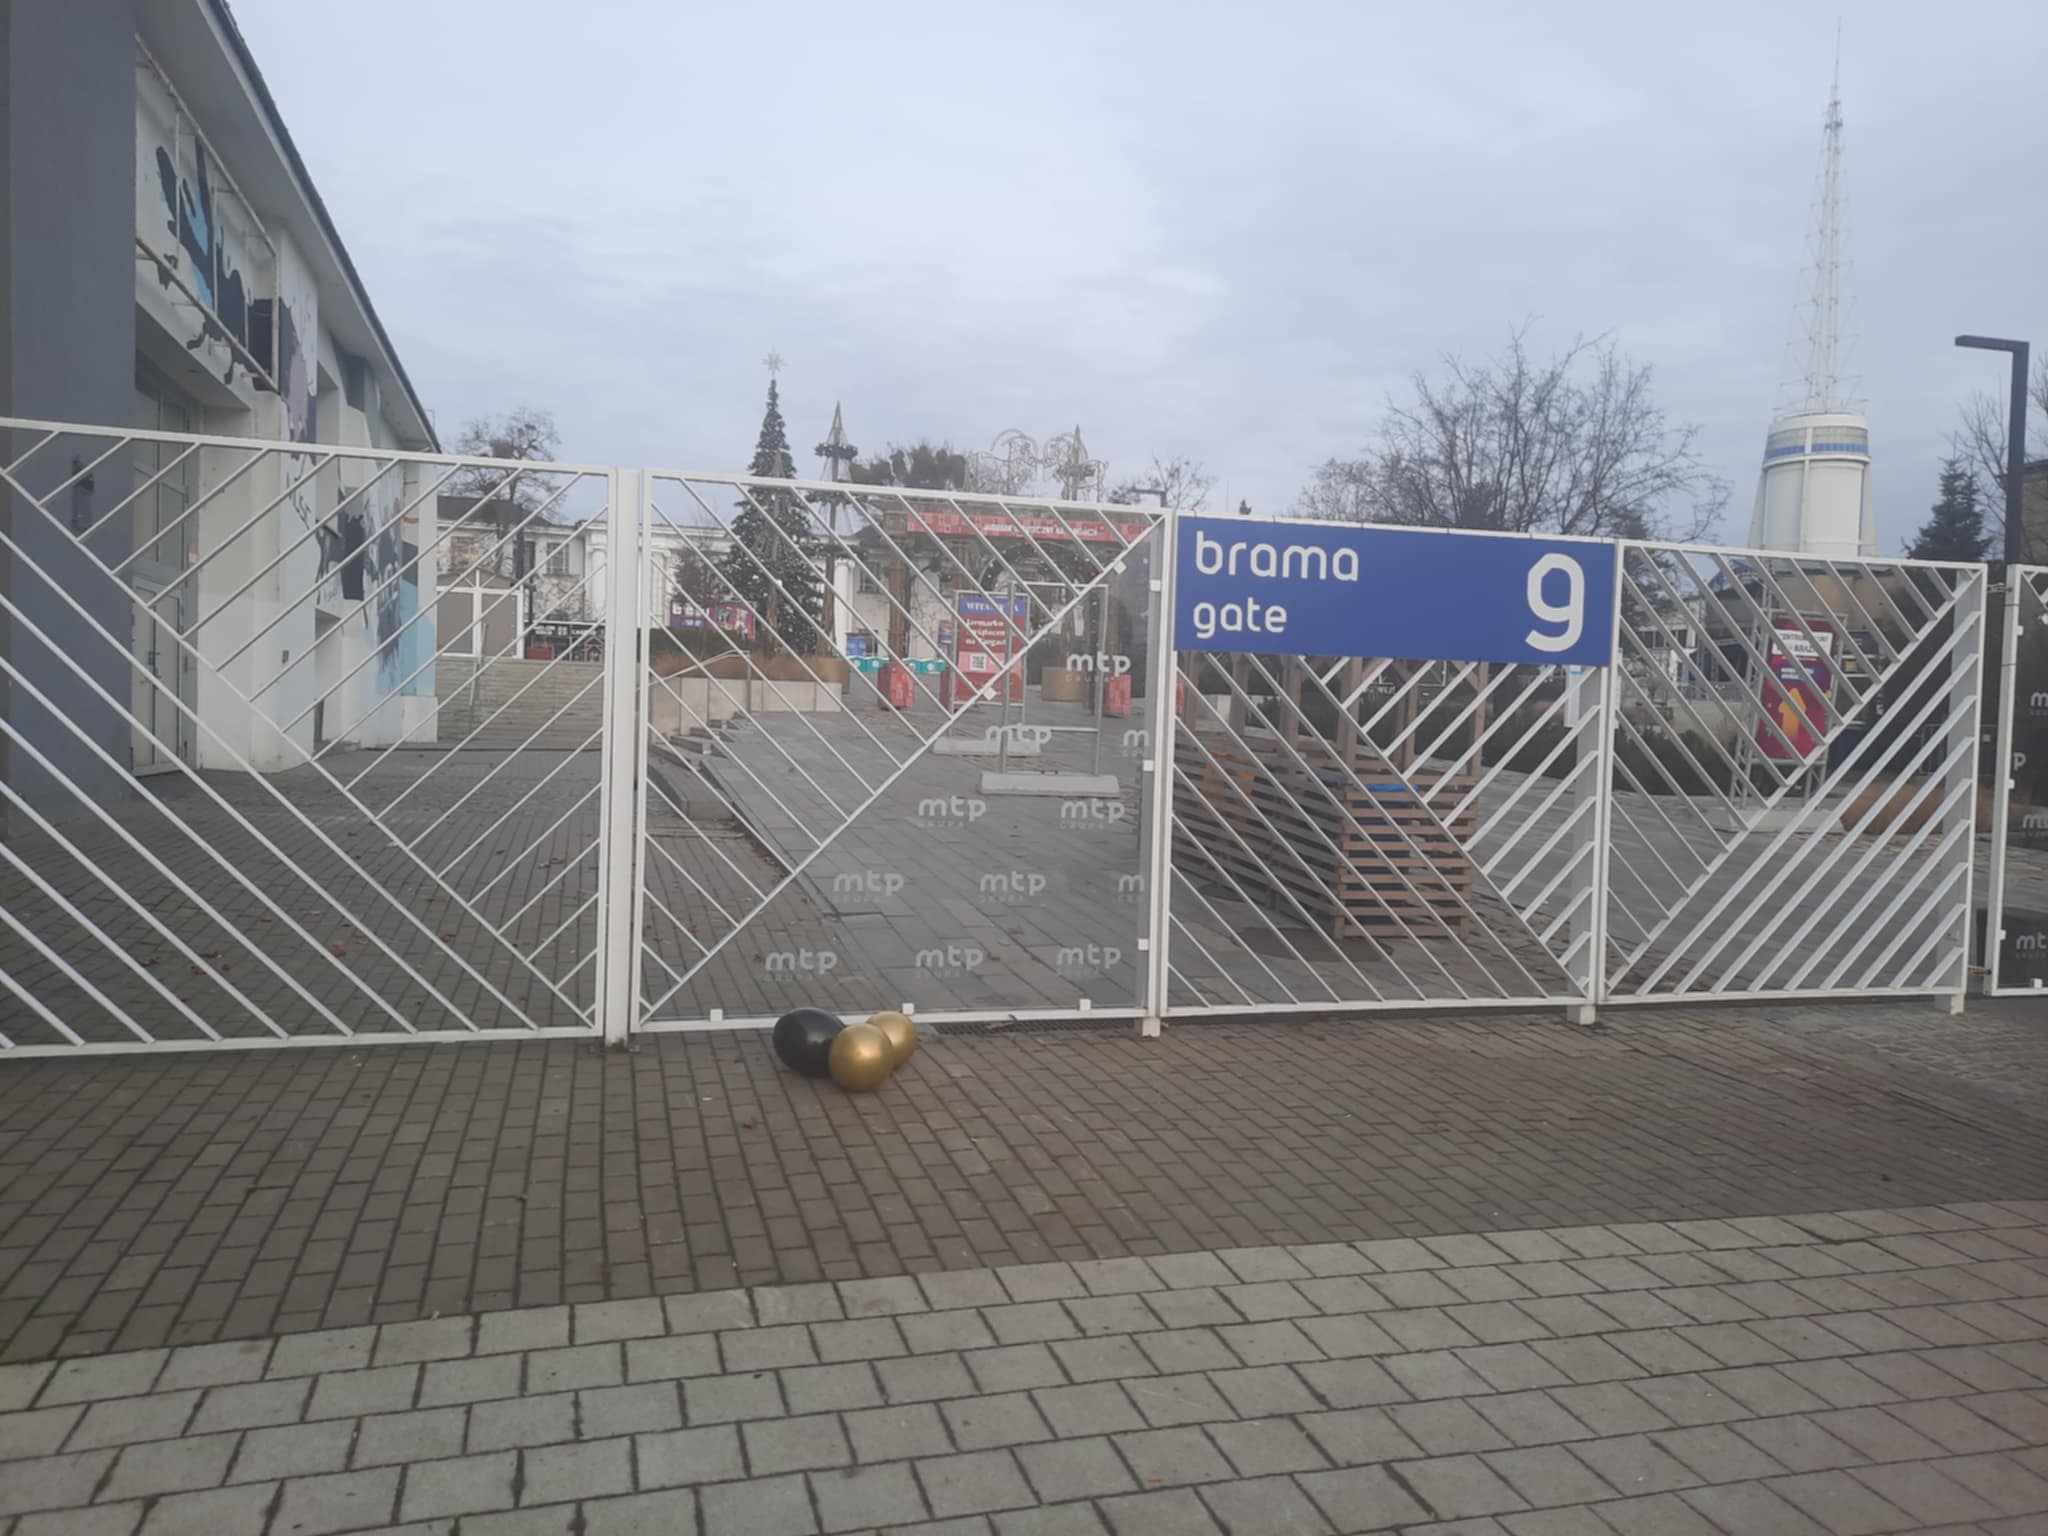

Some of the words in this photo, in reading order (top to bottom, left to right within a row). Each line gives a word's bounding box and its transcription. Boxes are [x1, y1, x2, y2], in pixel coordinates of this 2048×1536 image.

[1196, 530, 1359, 581] brama
[1193, 597, 1287, 639] gate
[1066, 651, 1131, 677] mtp
[985, 723, 1052, 745] mtp
[918, 796, 987, 822] mtp
[1061, 799, 1125, 823] mtp
[833, 870, 904, 897] mtp
[980, 871, 1046, 896] mtp
[765, 948, 837, 974] mtp
[915, 945, 984, 970] mtp
[1056, 944, 1121, 968] mtp
